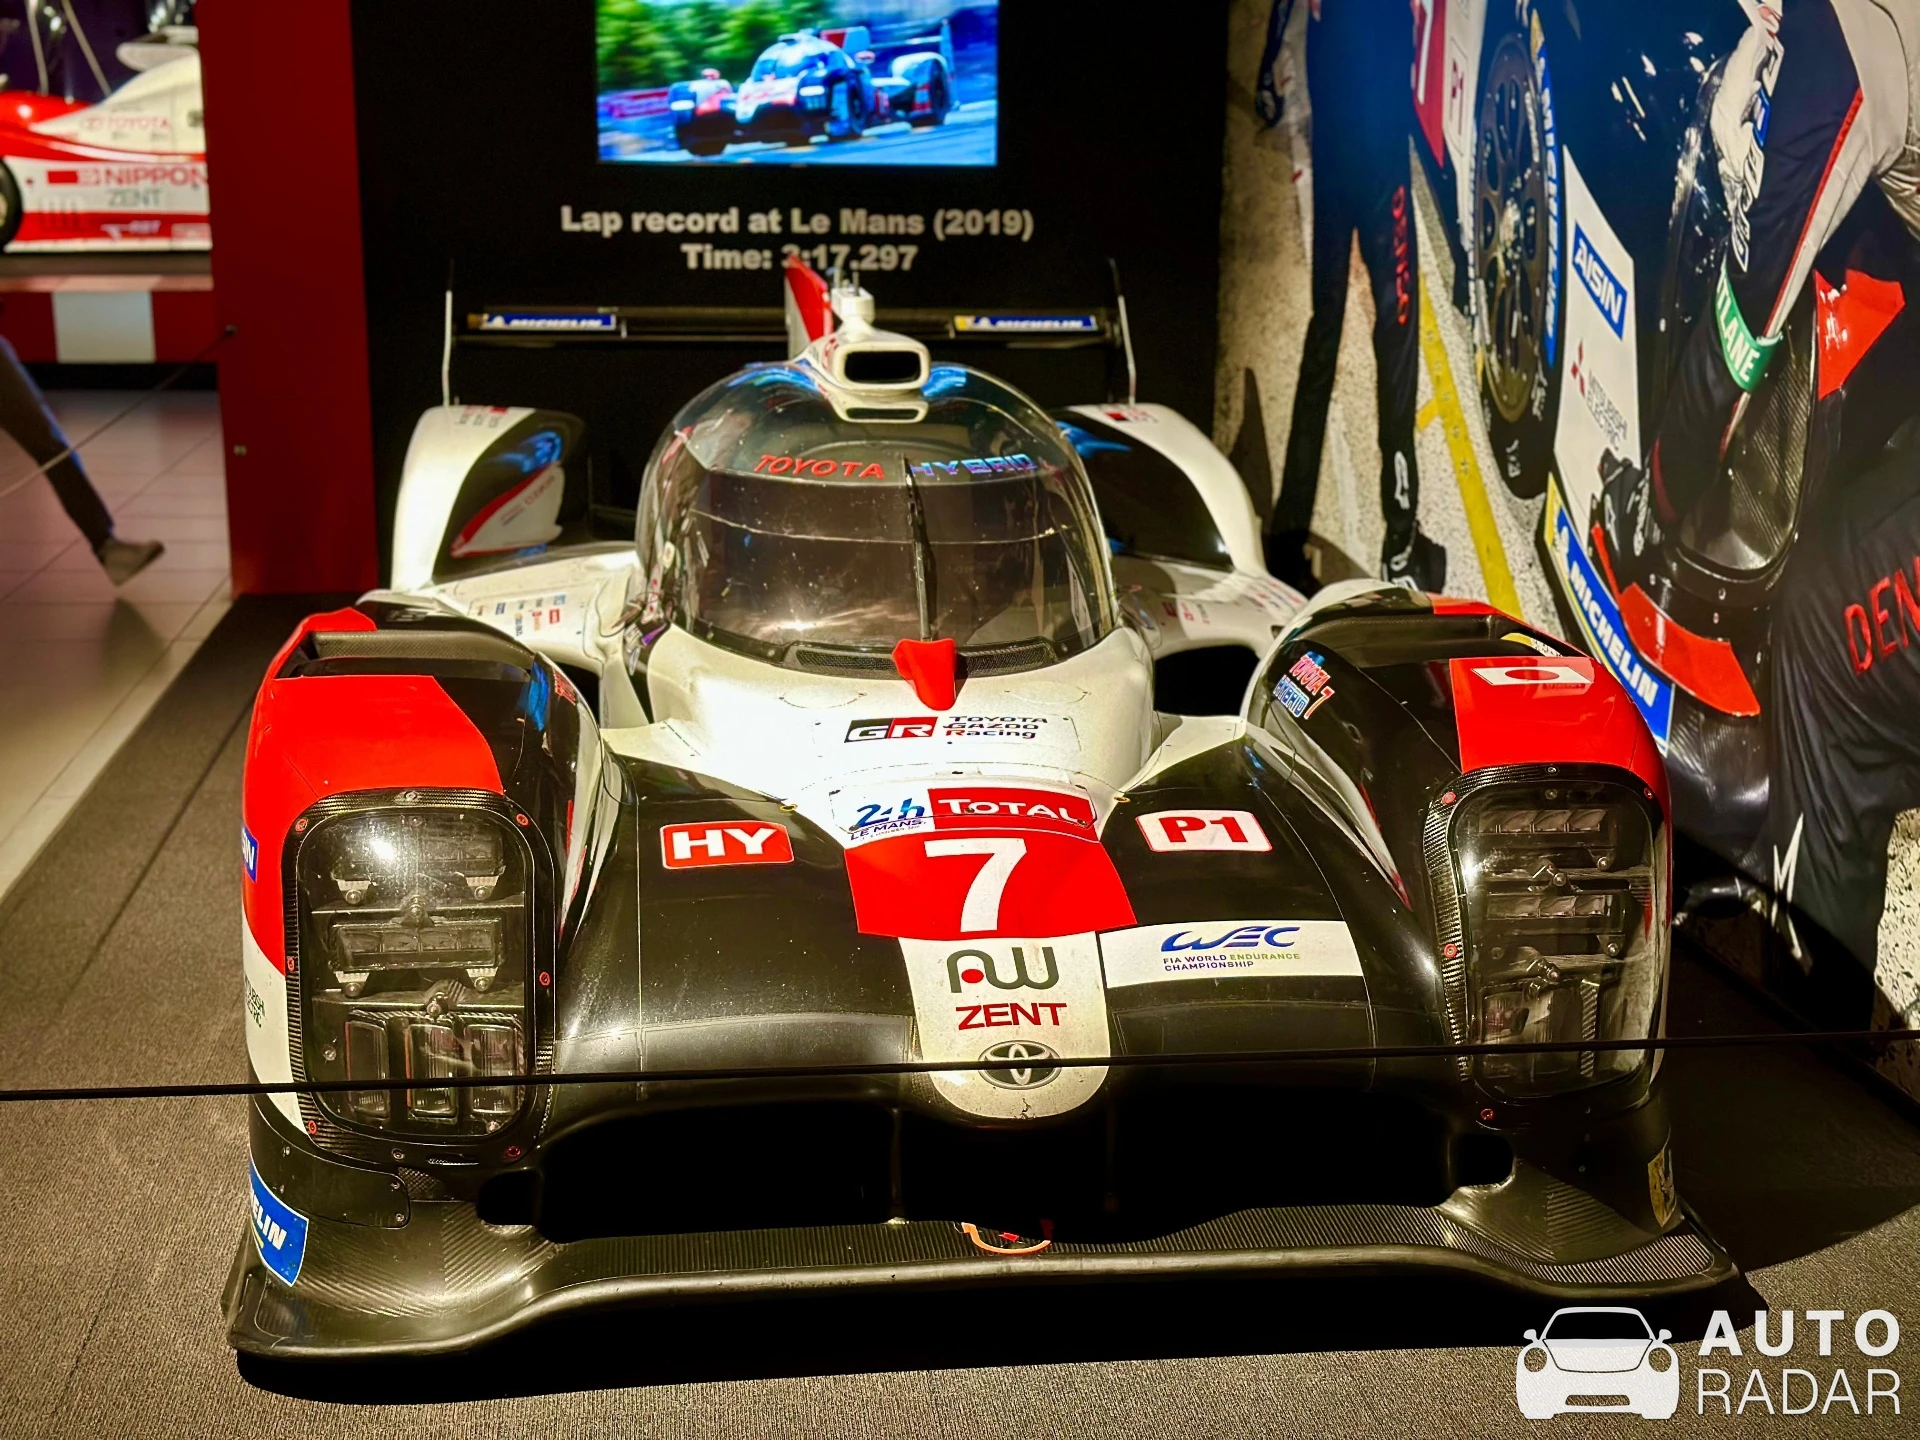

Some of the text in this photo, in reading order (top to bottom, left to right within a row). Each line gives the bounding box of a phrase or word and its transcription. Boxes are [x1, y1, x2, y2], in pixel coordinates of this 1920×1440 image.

[109, 189, 163, 207] ZENT
[560, 205, 1034, 242] Lap record at Le Mans (2019)
[681, 243, 772, 270] Time:
[1574, 238, 1624, 324] AISIN
[1719, 309, 1760, 382] LANE
[754, 453, 1039, 479] TOYOTA HYBRID
[1568, 561, 1659, 708] MICHELIN
[1289, 654, 1331, 696] TOYOTA
[1303, 686, 1336, 720] 7
[846, 715, 1048, 742] GR TOYOTA
[943, 722, 1039, 730] GAZOO
[945, 729, 1036, 740] Racing
[938, 797, 1087, 826] TOTAL
[851, 827, 871, 841] LE
[873, 818, 924, 833] MANS
[1158, 816, 1249, 843] P1
[672, 827, 777, 860] HY
[924, 837, 1027, 933] 7
[1160, 925, 1301, 952] WEC
[1164, 960, 1254, 972] CHAMPIONSHIP
[1184, 954, 1227, 963] WORLD
[1230, 953, 1301, 961] ENDURANCE
[956, 1002, 1067, 1031] ZENT
